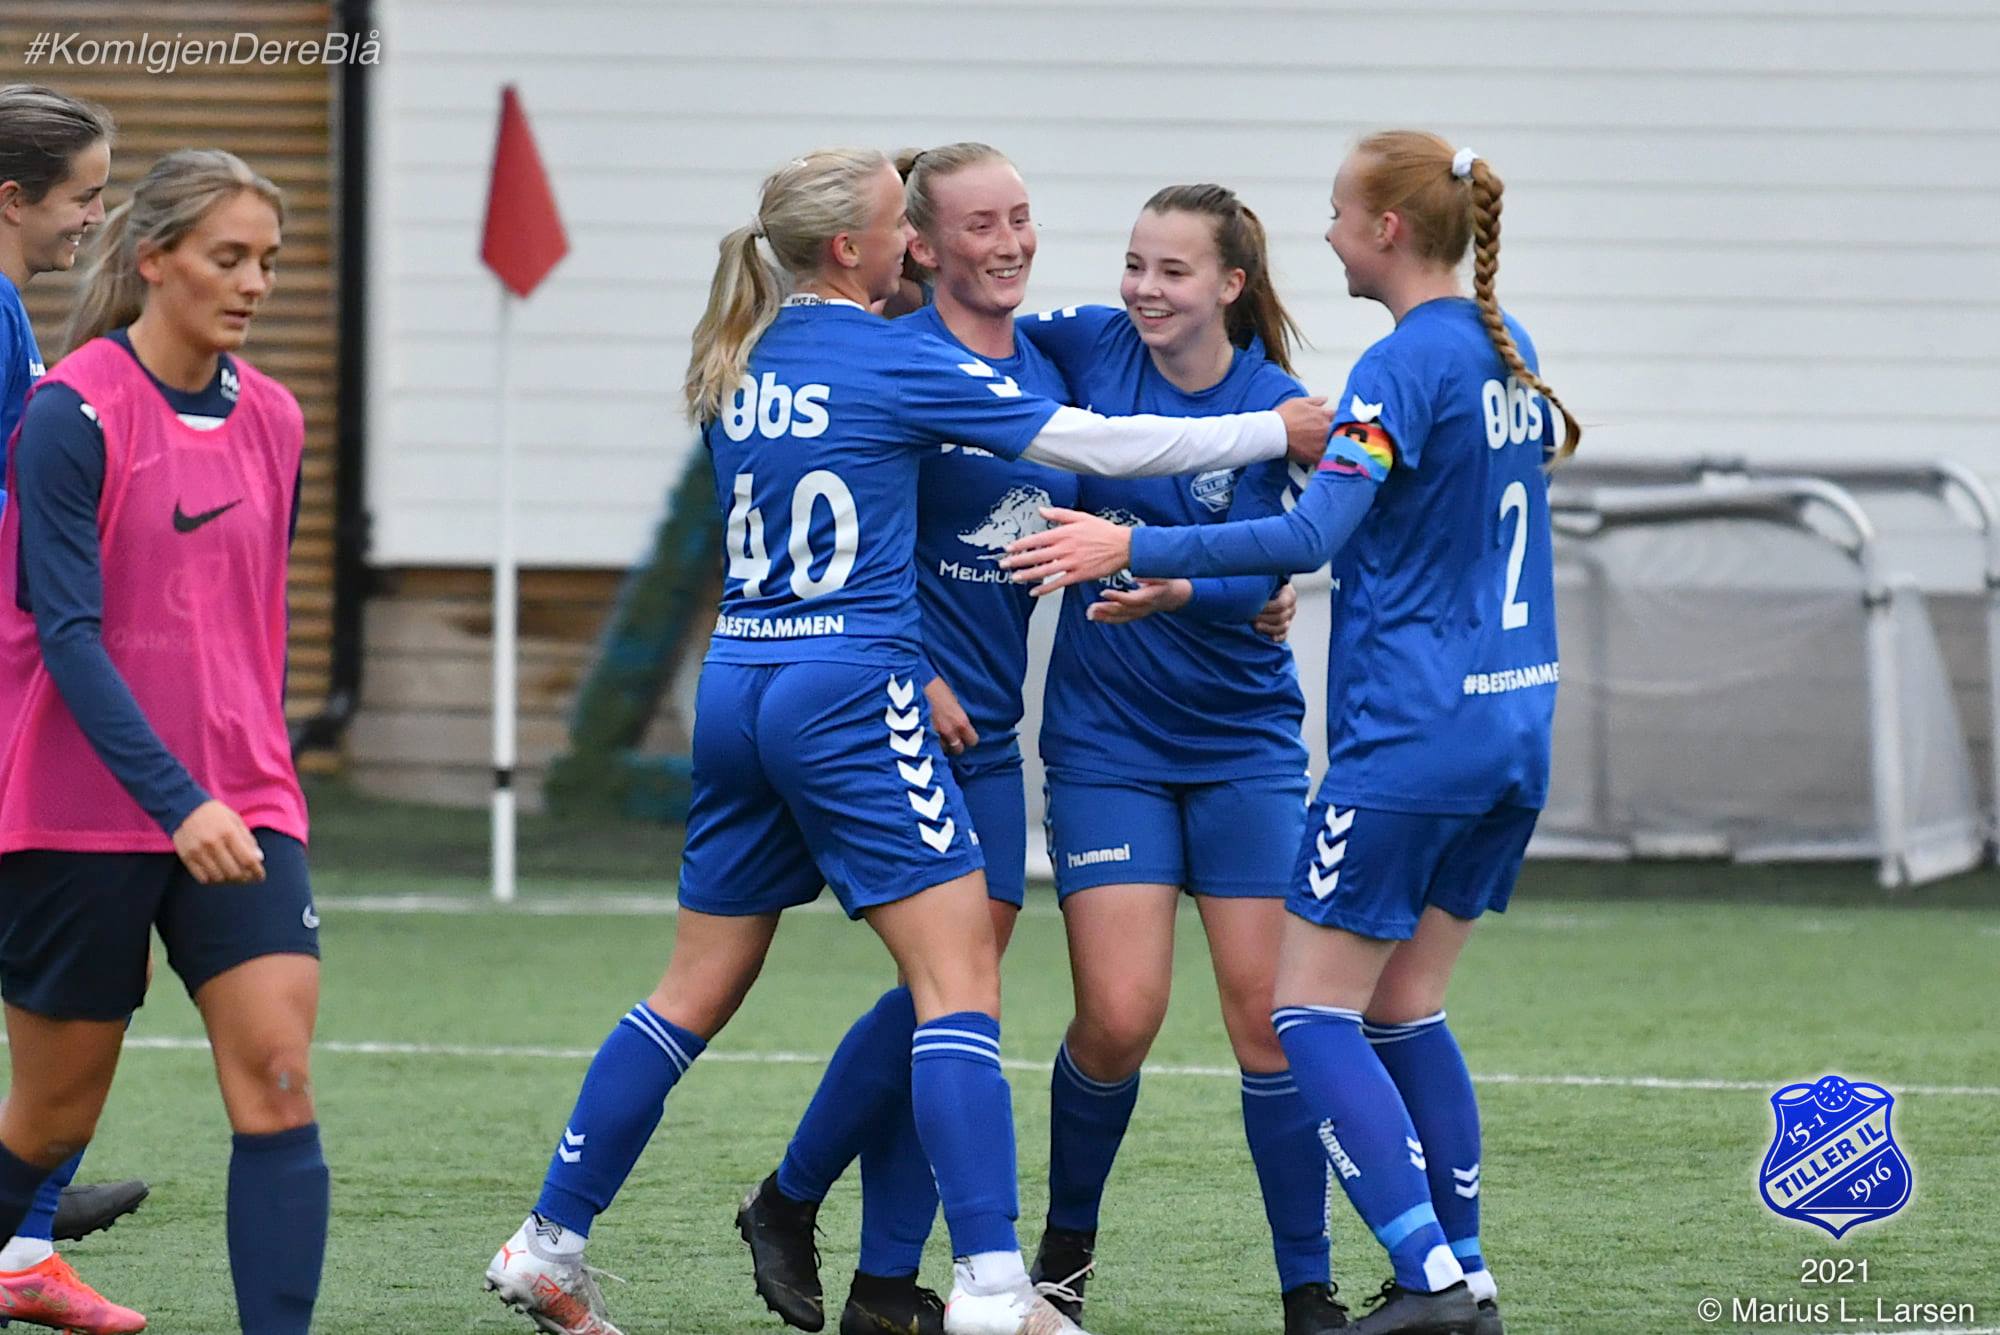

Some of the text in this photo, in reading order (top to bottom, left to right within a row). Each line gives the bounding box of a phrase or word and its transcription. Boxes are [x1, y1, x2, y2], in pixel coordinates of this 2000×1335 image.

[726, 469, 859, 600] 40
[1499, 481, 1528, 630] 2
[715, 614, 844, 638] BESTSAMMEN
[1462, 661, 1559, 695] #BESTSAMME
[1066, 843, 1131, 869] hummel
